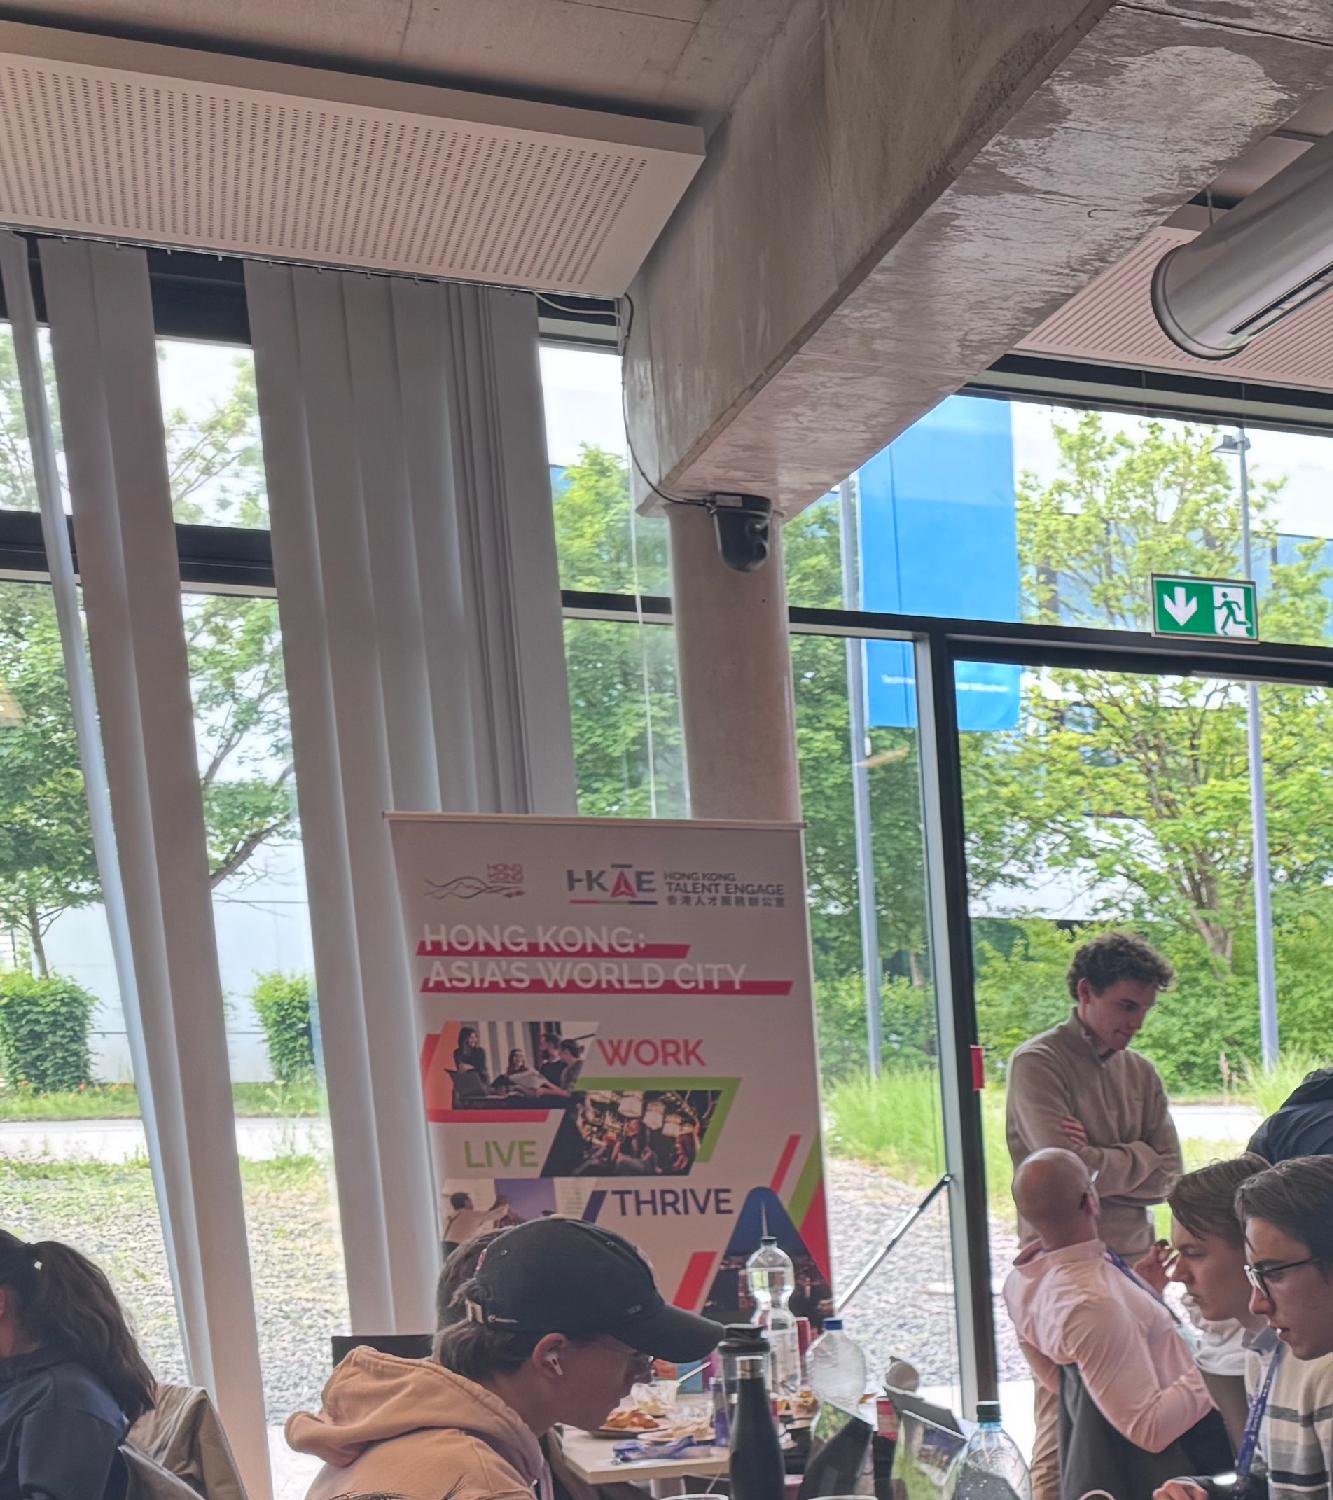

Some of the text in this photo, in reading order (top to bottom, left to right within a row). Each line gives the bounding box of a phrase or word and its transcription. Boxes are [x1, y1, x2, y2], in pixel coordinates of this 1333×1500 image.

[664, 872, 735, 882] HONG KONG
[665, 882, 784, 895] TALENT ENGAGE
[423, 924, 646, 954] HONG KONG:
[428, 960, 747, 991] ASIA'S WORLD CITY
[597, 1039, 706, 1067] WORK
[464, 1140, 539, 1168] LIVE
[611, 1188, 734, 1216] THRIVE
